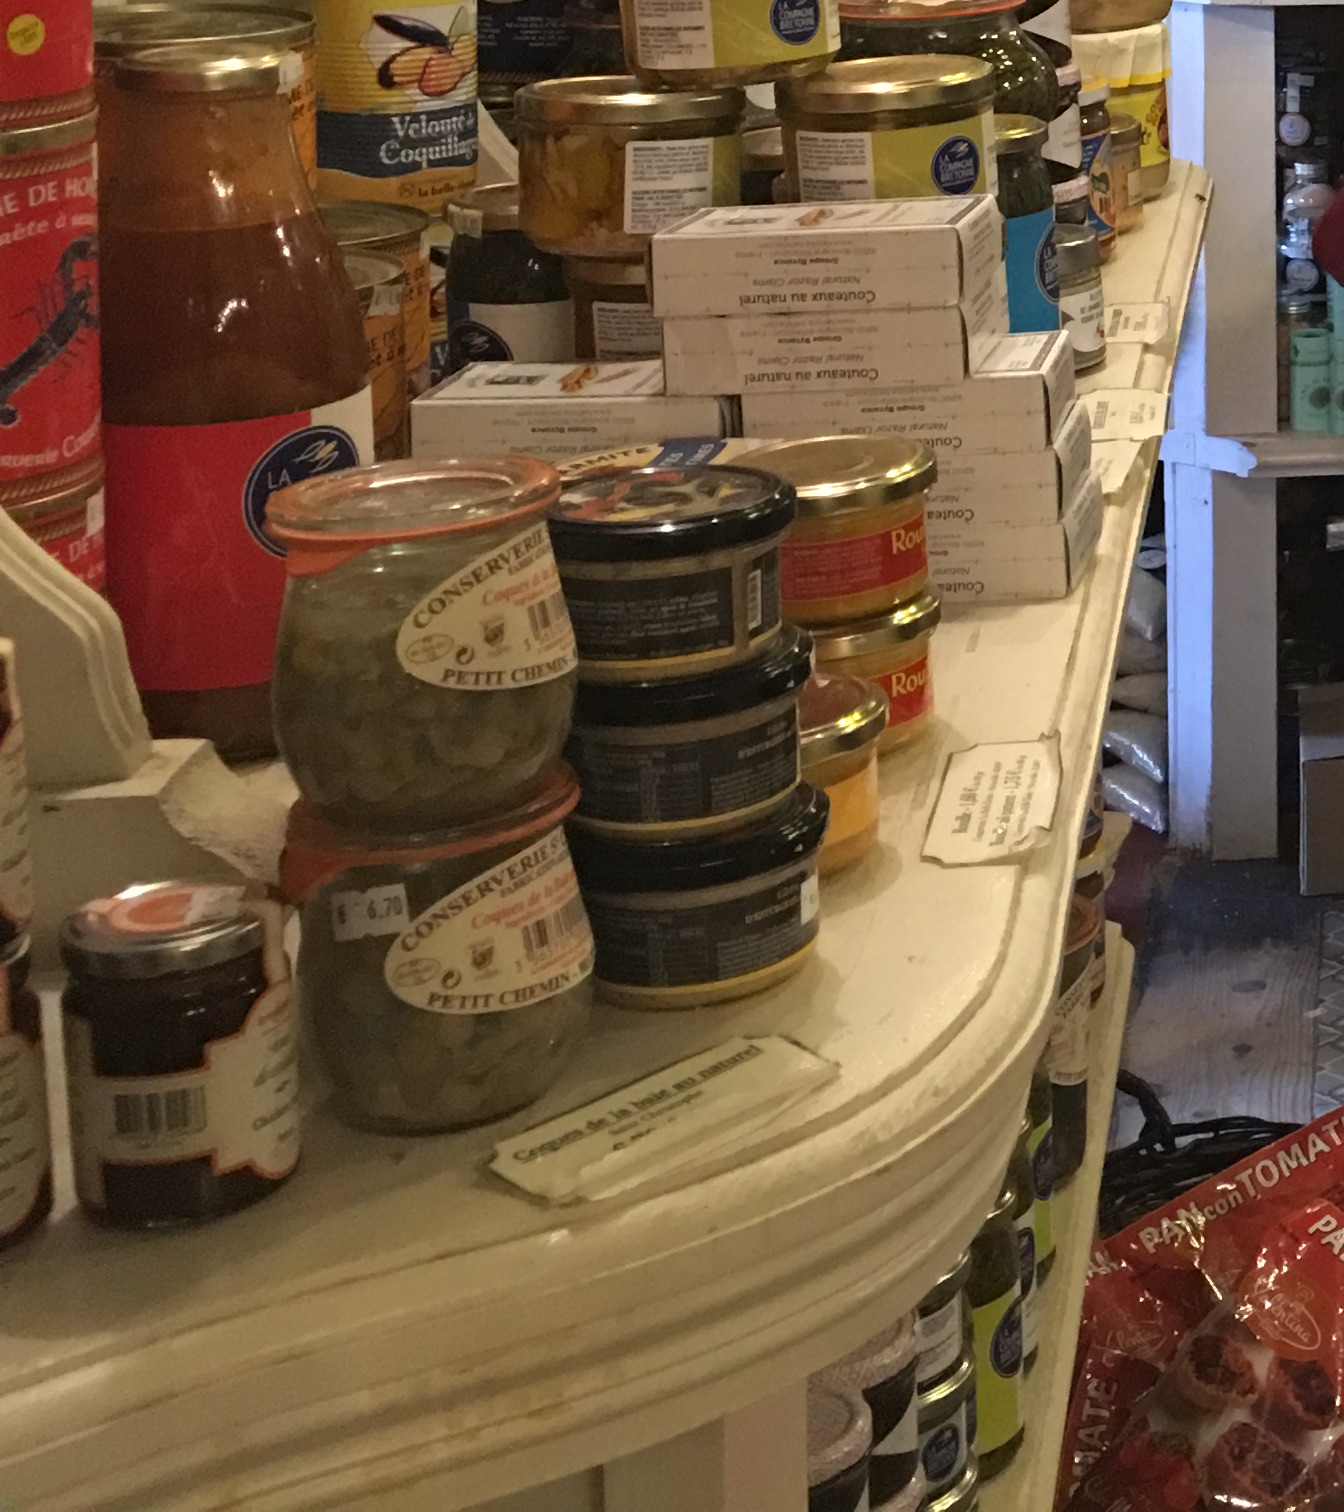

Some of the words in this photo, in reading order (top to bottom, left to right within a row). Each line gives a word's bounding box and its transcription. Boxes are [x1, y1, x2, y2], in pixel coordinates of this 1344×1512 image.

[390, 109, 465, 139] Velouté
[939, 153, 951, 164] LA
[28, 180, 58, 207] DE
[752, 275, 786, 287] Clams
[787, 275, 820, 287] Razor
[821, 275, 862, 286] Natural
[738, 291, 788, 307] naturel
[791, 292, 808, 303] au
[811, 289, 877, 304] Couteaux
[756, 354, 789, 366] Clams
[792, 353, 823, 365] Razor
[824, 352, 864, 364] Natural
[743, 370, 793, 385] naturel
[796, 369, 813, 380] au
[815, 366, 879, 382] Couteaux
[876, 422, 908, 434] Razor
[909, 422, 949, 433] Natural
[267, 468, 293, 490] LA
[926, 507, 975, 521] Coutea
[412, 527, 544, 630] CONSERVERIE
[441, 667, 507, 686] PETIT
[510, 656, 569, 683] CHEMIN
[399, 849, 549, 953] CONSERVERIE
[426, 990, 496, 1010] PETIT
[499, 969, 572, 1006] CHEMIN
[585, 1115, 607, 1134] de
[607, 1106, 632, 1125] la
[631, 1087, 670, 1113] baie
[671, 1075, 698, 1094] au
[698, 1044, 766, 1081] naturel
[1138, 1201, 1207, 1254] PAN
[1203, 1190, 1244, 1225] con
